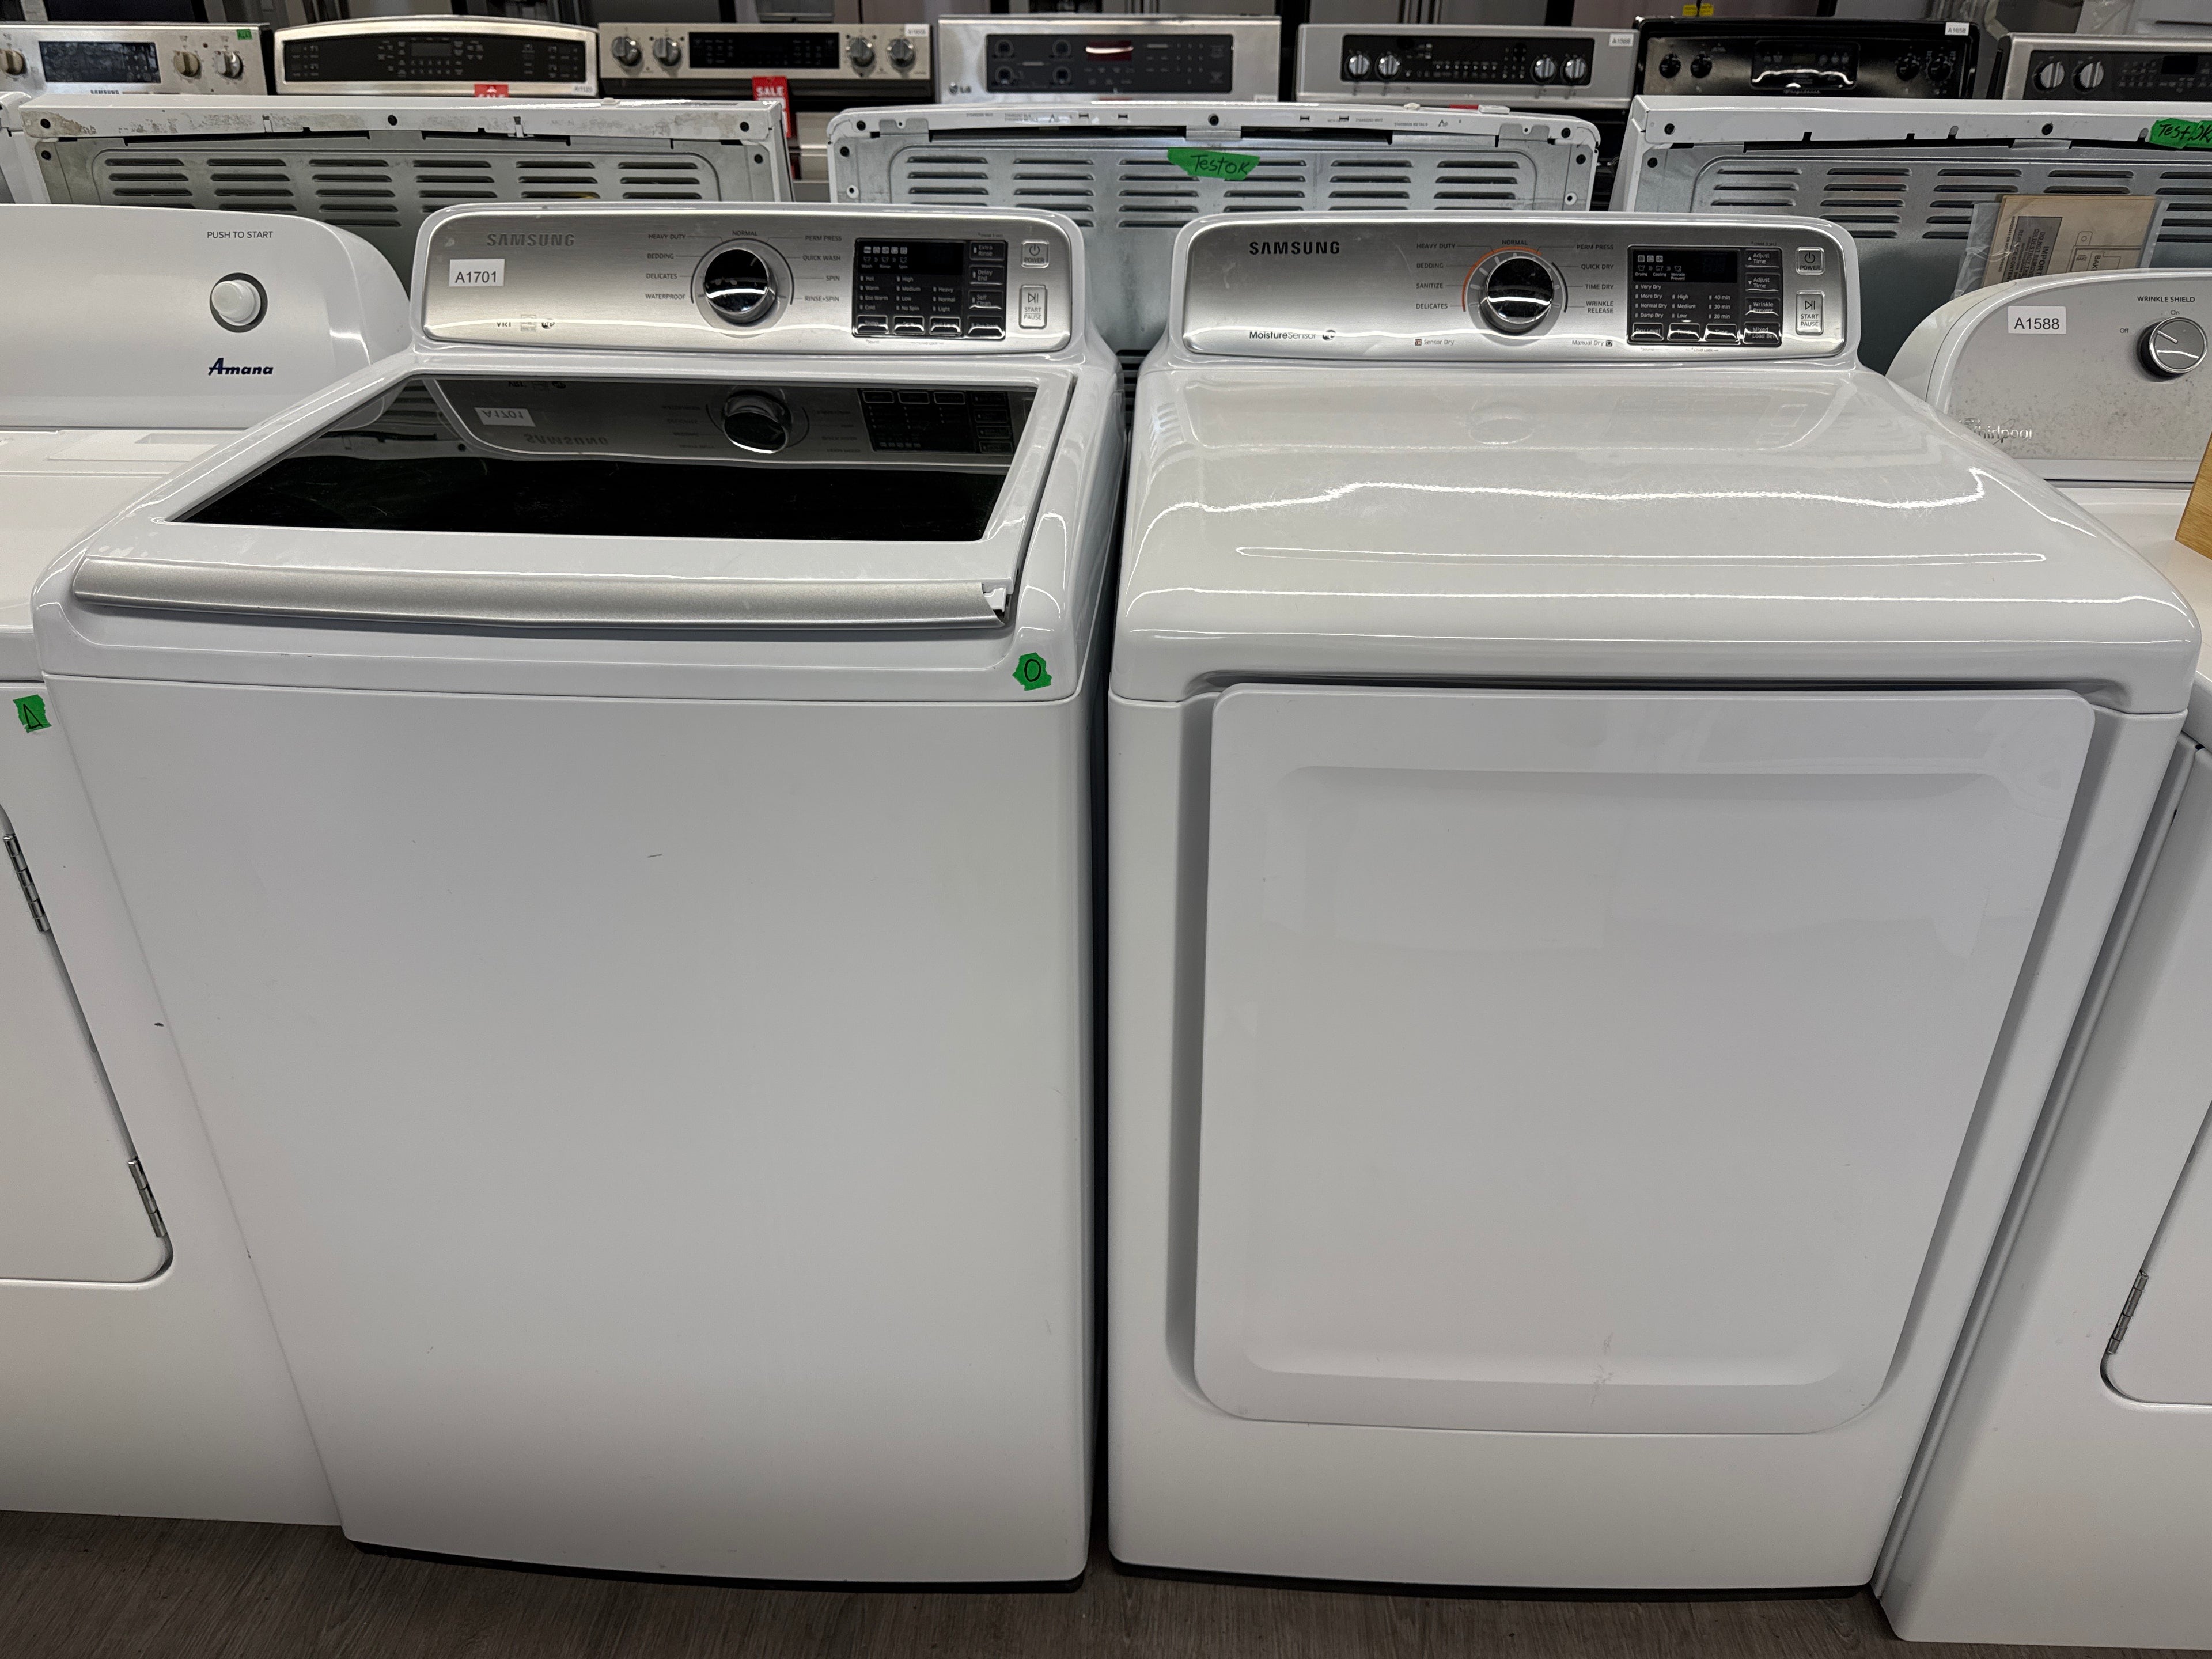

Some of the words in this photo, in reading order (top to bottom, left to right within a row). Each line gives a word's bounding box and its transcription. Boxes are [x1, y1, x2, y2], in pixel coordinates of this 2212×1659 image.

[756, 86, 784, 96] SALE
[487, 233, 575, 247] SAMSUNG
[1249, 241, 1340, 255] SAMSUNG
[454, 271, 497, 283] A1701
[2014, 317, 2060, 329] A1588
[208, 357, 274, 376] Amana
